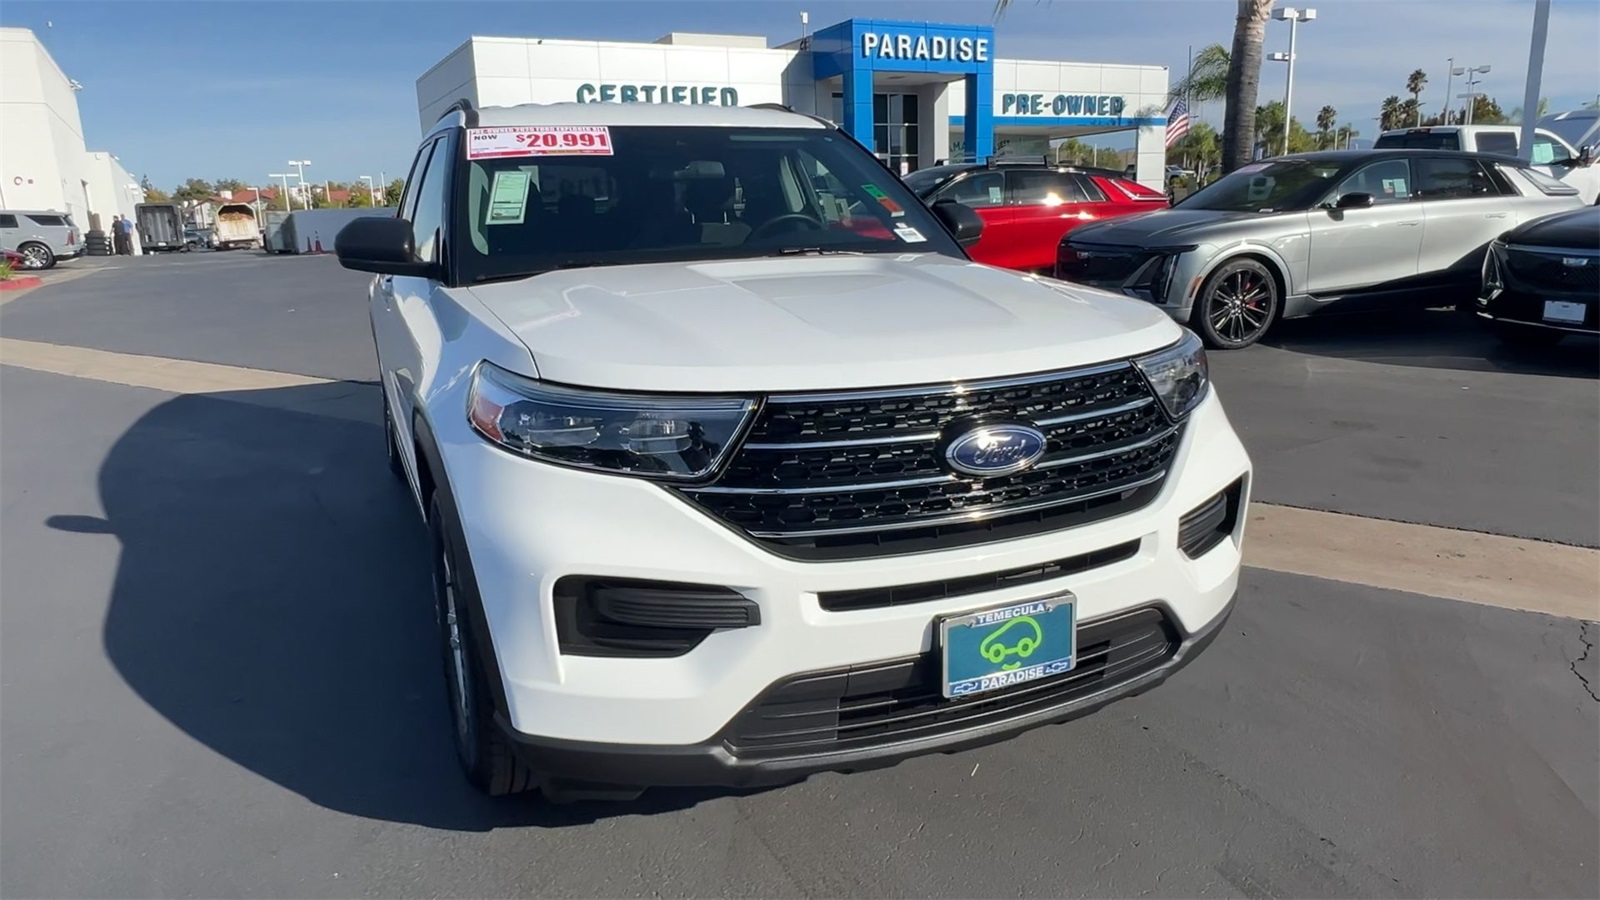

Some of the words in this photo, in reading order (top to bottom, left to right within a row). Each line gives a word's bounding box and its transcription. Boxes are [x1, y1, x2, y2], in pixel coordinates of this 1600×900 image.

[862, 32, 989, 62] PARADISE
[576, 83, 738, 107] CERTIFIED
[1002, 93, 1125, 116] PRE-OWNED
[973, 431, 1026, 464] Ford
[977, 603, 1045, 624] TEMECULA
[980, 666, 1045, 690] PARADISE
